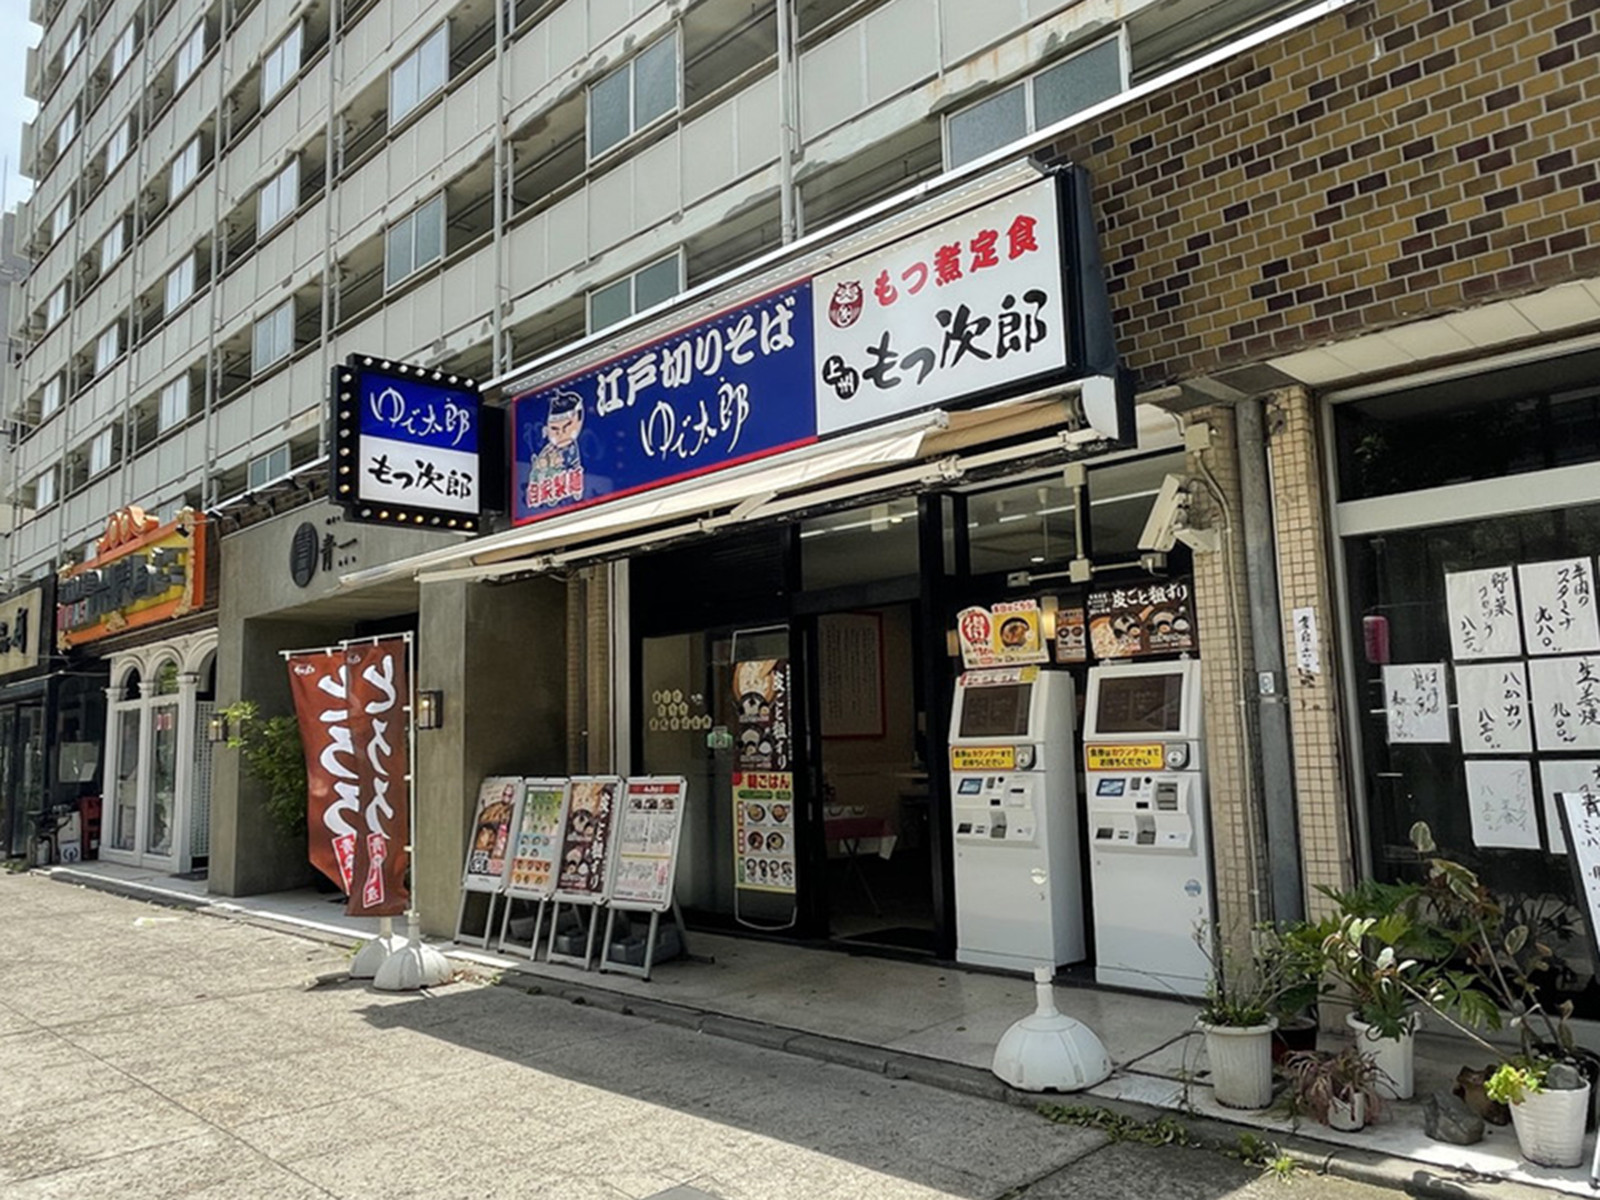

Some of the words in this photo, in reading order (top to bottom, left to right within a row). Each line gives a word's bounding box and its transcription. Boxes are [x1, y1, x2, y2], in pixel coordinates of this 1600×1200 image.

[874, 215, 1039, 307] もつ煮定食
[597, 296, 796, 417] 江戸切りそば
[862, 289, 1048, 389] もつ次郎
[370, 387, 471, 446] ゆで太郎
[640, 377, 749, 461] ゆで太郎
[368, 454, 473, 499] もつ次郎
